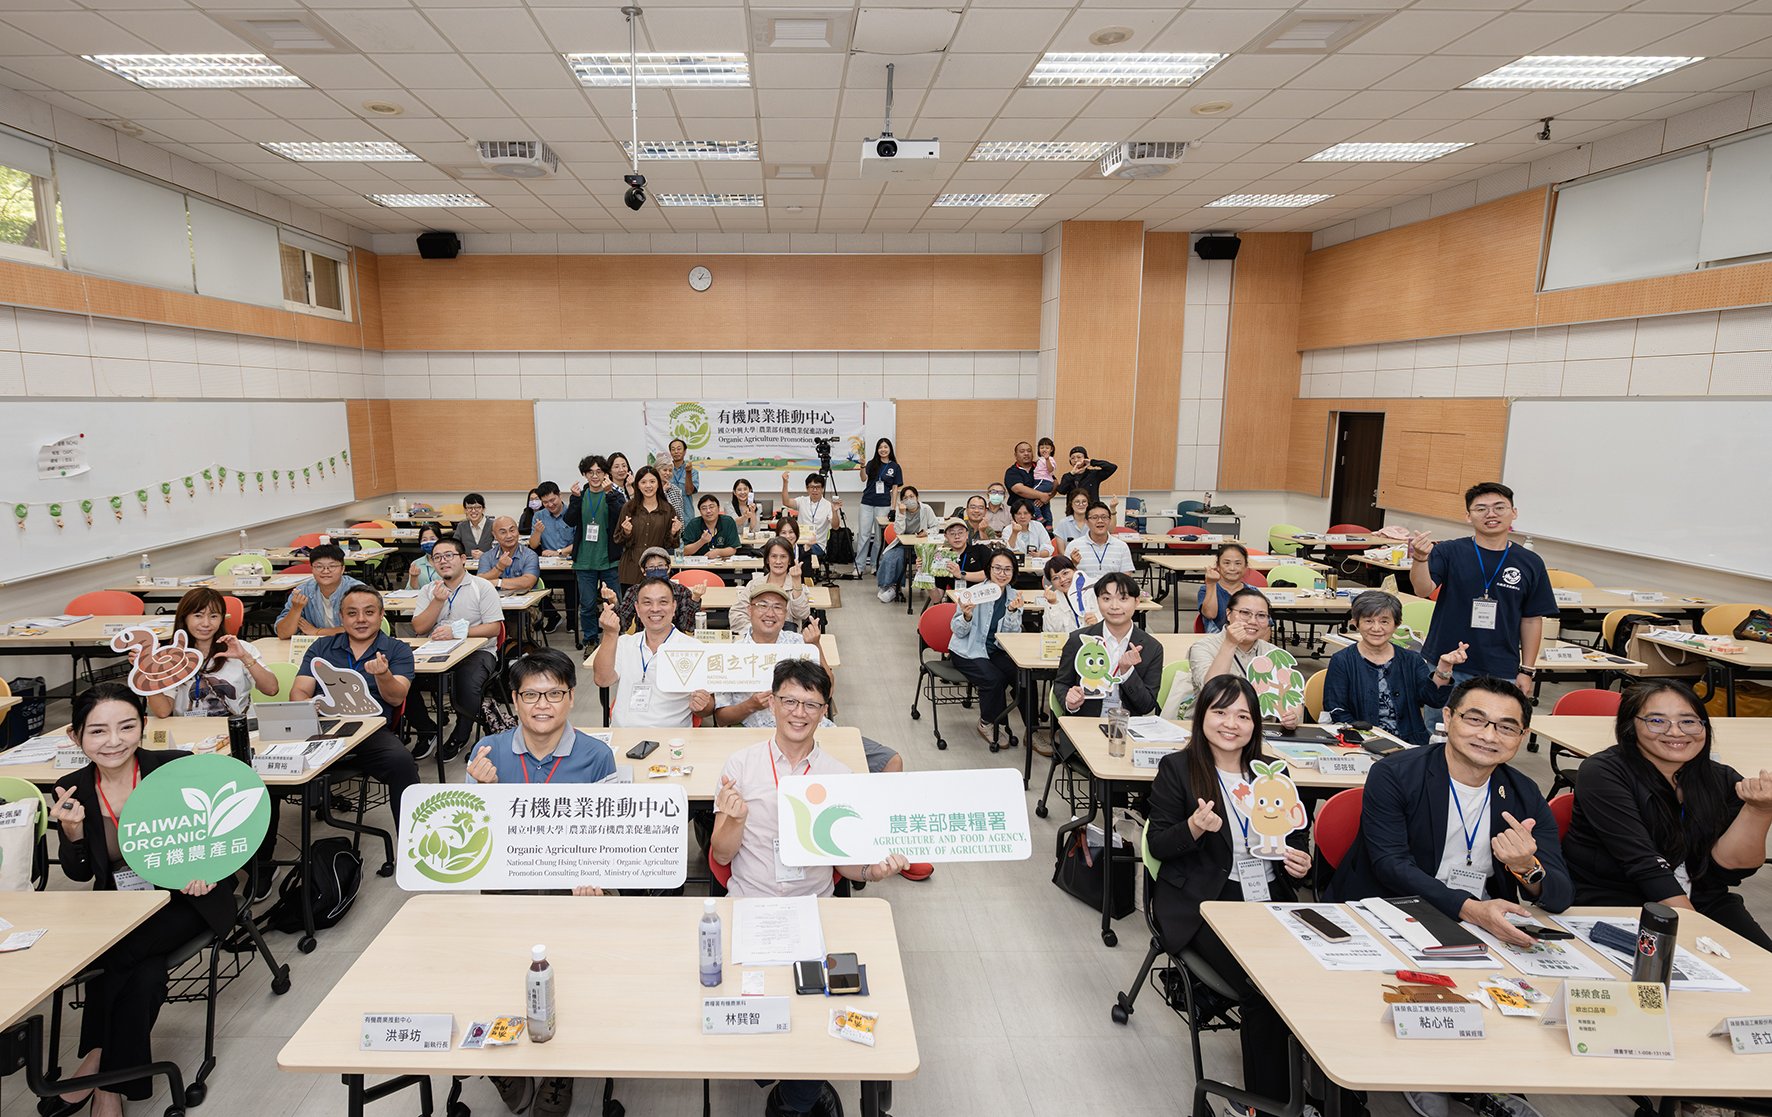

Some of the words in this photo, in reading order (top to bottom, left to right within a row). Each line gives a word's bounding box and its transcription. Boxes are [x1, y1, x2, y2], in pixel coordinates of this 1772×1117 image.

[718, 409, 835, 424] 有機農業推動中心
[707, 653, 811, 678] 國立中興
[509, 797, 680, 818] 有機農業推動中心
[124, 812, 206, 837] TAIWAN
[890, 811, 1006, 833] 農業部農糧署
[508, 825, 565, 835] 國立中興大學
[569, 825, 680, 835] 農業部有機農業促進諮詢會
[123, 829, 206, 853] ORGANIC
[873, 834, 935, 845] AGRICULTURE
[938, 834, 957, 844] AND
[960, 833, 984, 843] FOOD
[988, 832, 1027, 843] AGENCY,
[144, 837, 248, 869] 有機農產品
[507, 844, 543, 855] Organic
[545, 844, 597, 855] Agriculture
[599, 845, 647, 854] Promotion
[649, 845, 679, 854] Center
[889, 846, 932, 856] MINISTRY
[935, 845, 946, 854] OF
[950, 844, 1013, 854] AGRICULTURE
[535, 859, 557, 868] Chung
[558, 859, 576, 868] Hsing
[578, 859, 610, 868] University
[616, 859, 641, 867] Organic
[643, 859, 679, 867] Agriculture
[544, 870, 579, 878] Consulting
[580, 870, 601, 878] Board,
[604, 870, 631, 878] Ministry
[641, 870, 676, 878] Agriculture
[1570, 988, 1611, 1000] 味榮食品
[725, 1013, 760, 1026] 林巽智
[1419, 1016, 1454, 1029] 粘心怡
[385, 1029, 422, 1042] 洪爭坊
[1751, 1032, 1772, 1045] 許立
